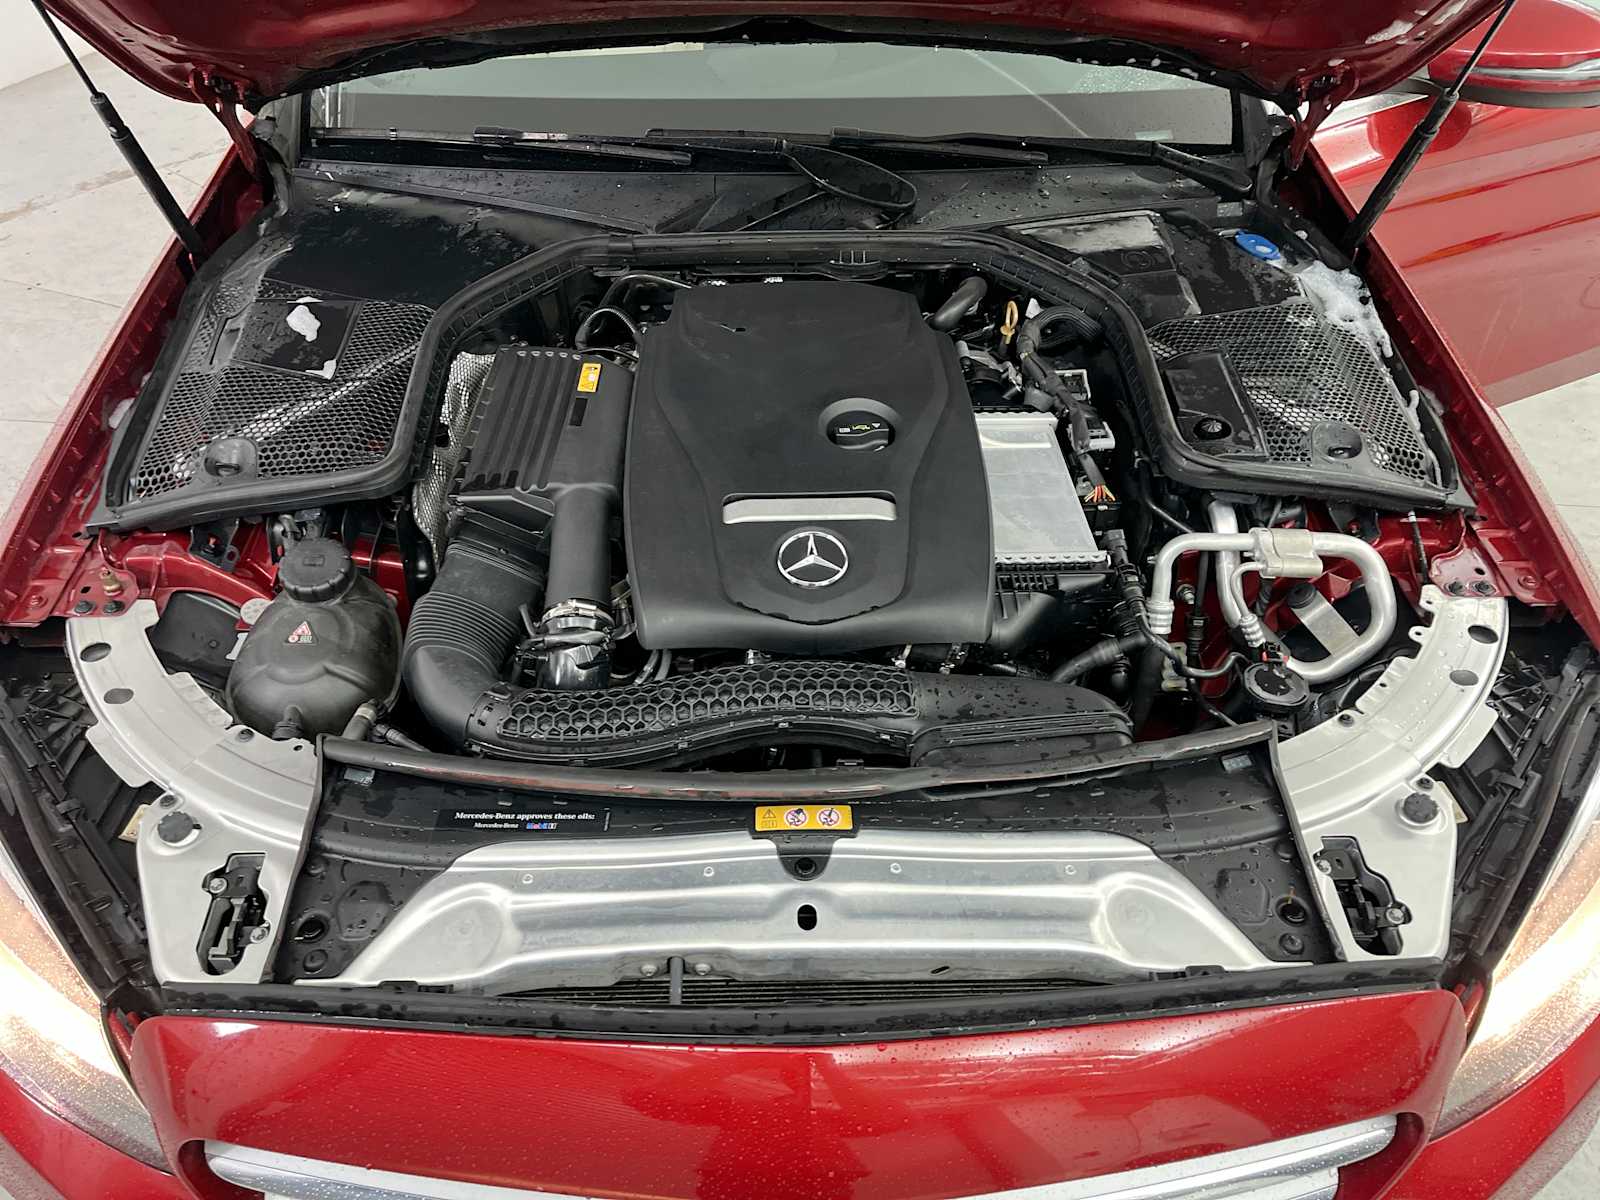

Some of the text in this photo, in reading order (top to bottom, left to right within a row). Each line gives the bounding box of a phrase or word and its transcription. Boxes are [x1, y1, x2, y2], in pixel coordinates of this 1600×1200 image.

[454, 812, 595, 821] Mercedes-Benz approves these oils:
